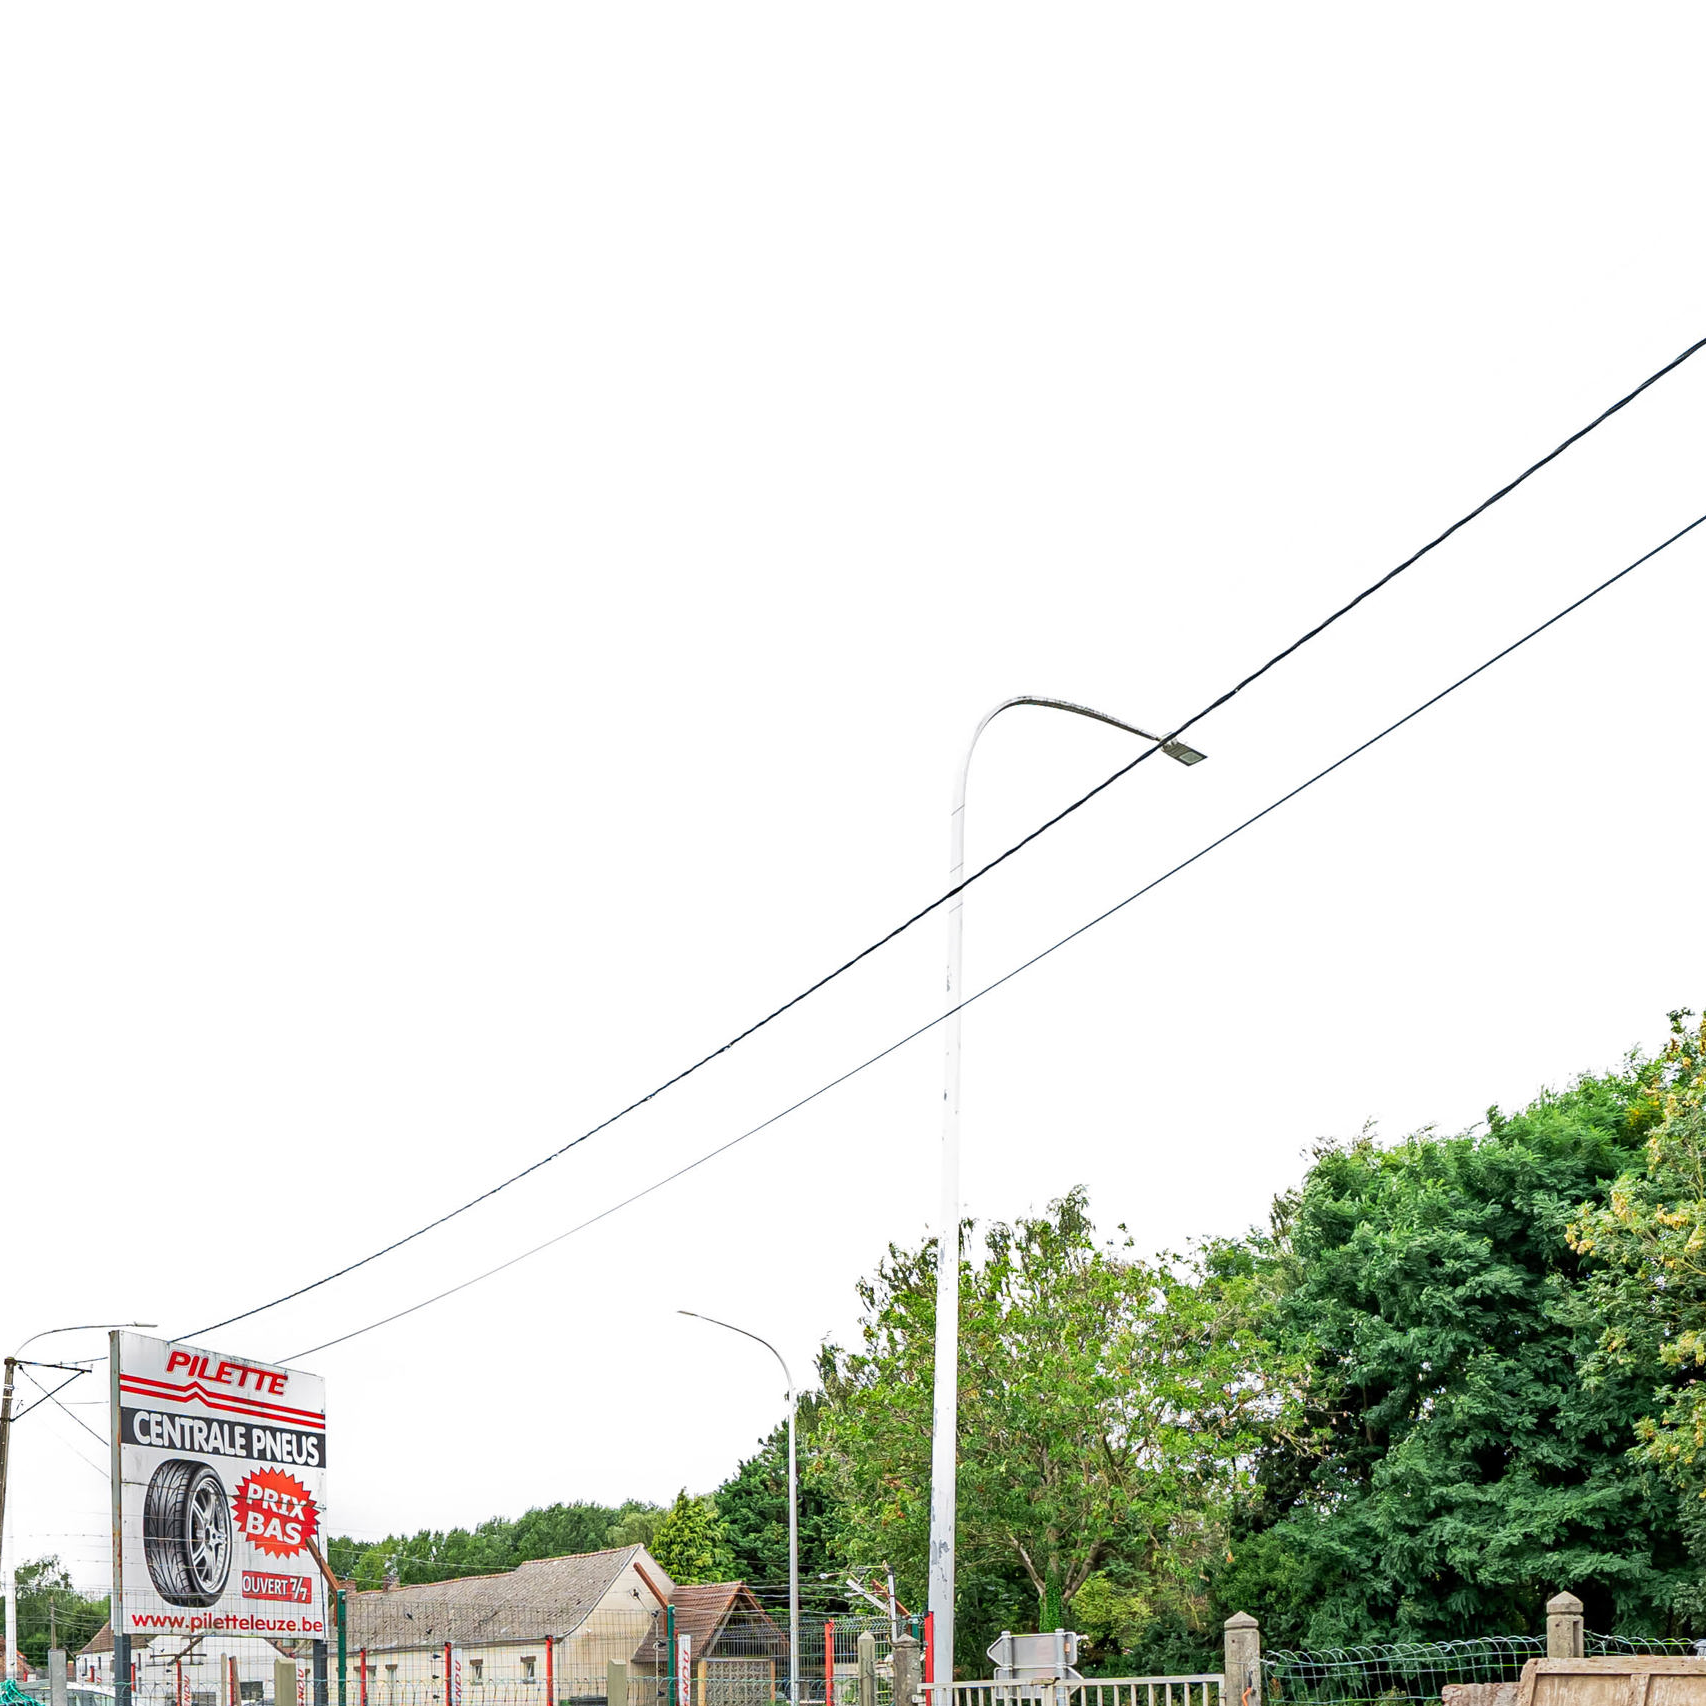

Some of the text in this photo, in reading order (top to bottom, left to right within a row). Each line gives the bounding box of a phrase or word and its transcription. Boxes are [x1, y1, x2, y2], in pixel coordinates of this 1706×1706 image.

[166, 1350, 289, 1396] PILETTE
[133, 1411, 320, 1466] CENTRALE PNEUS
[246, 1483, 308, 1521] PRIX
[245, 1511, 303, 1545] BAS
[243, 1575, 308, 1601] OUVERT 7/7
[131, 1612, 324, 1633] www.piletteleuze.be
